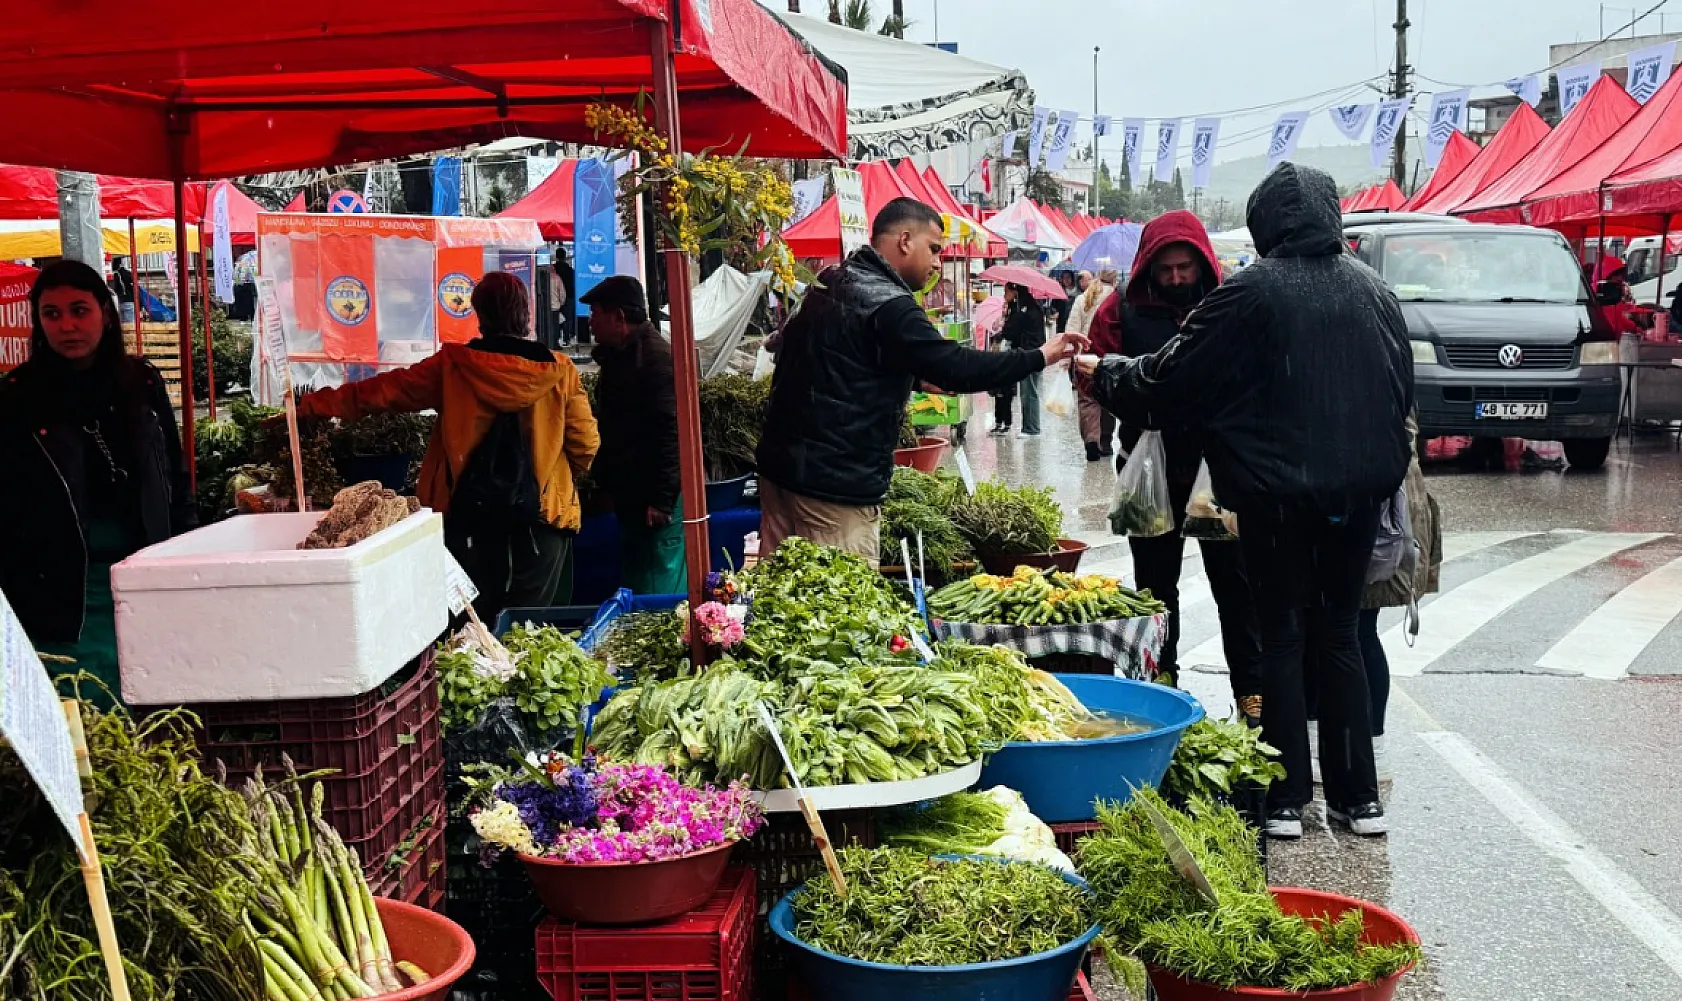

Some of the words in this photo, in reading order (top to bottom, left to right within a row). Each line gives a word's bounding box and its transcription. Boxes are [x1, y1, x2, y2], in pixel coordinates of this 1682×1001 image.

[1482, 403, 1497, 416] 48
[1501, 403, 1518, 416] TC
[1522, 403, 1545, 416] 771
